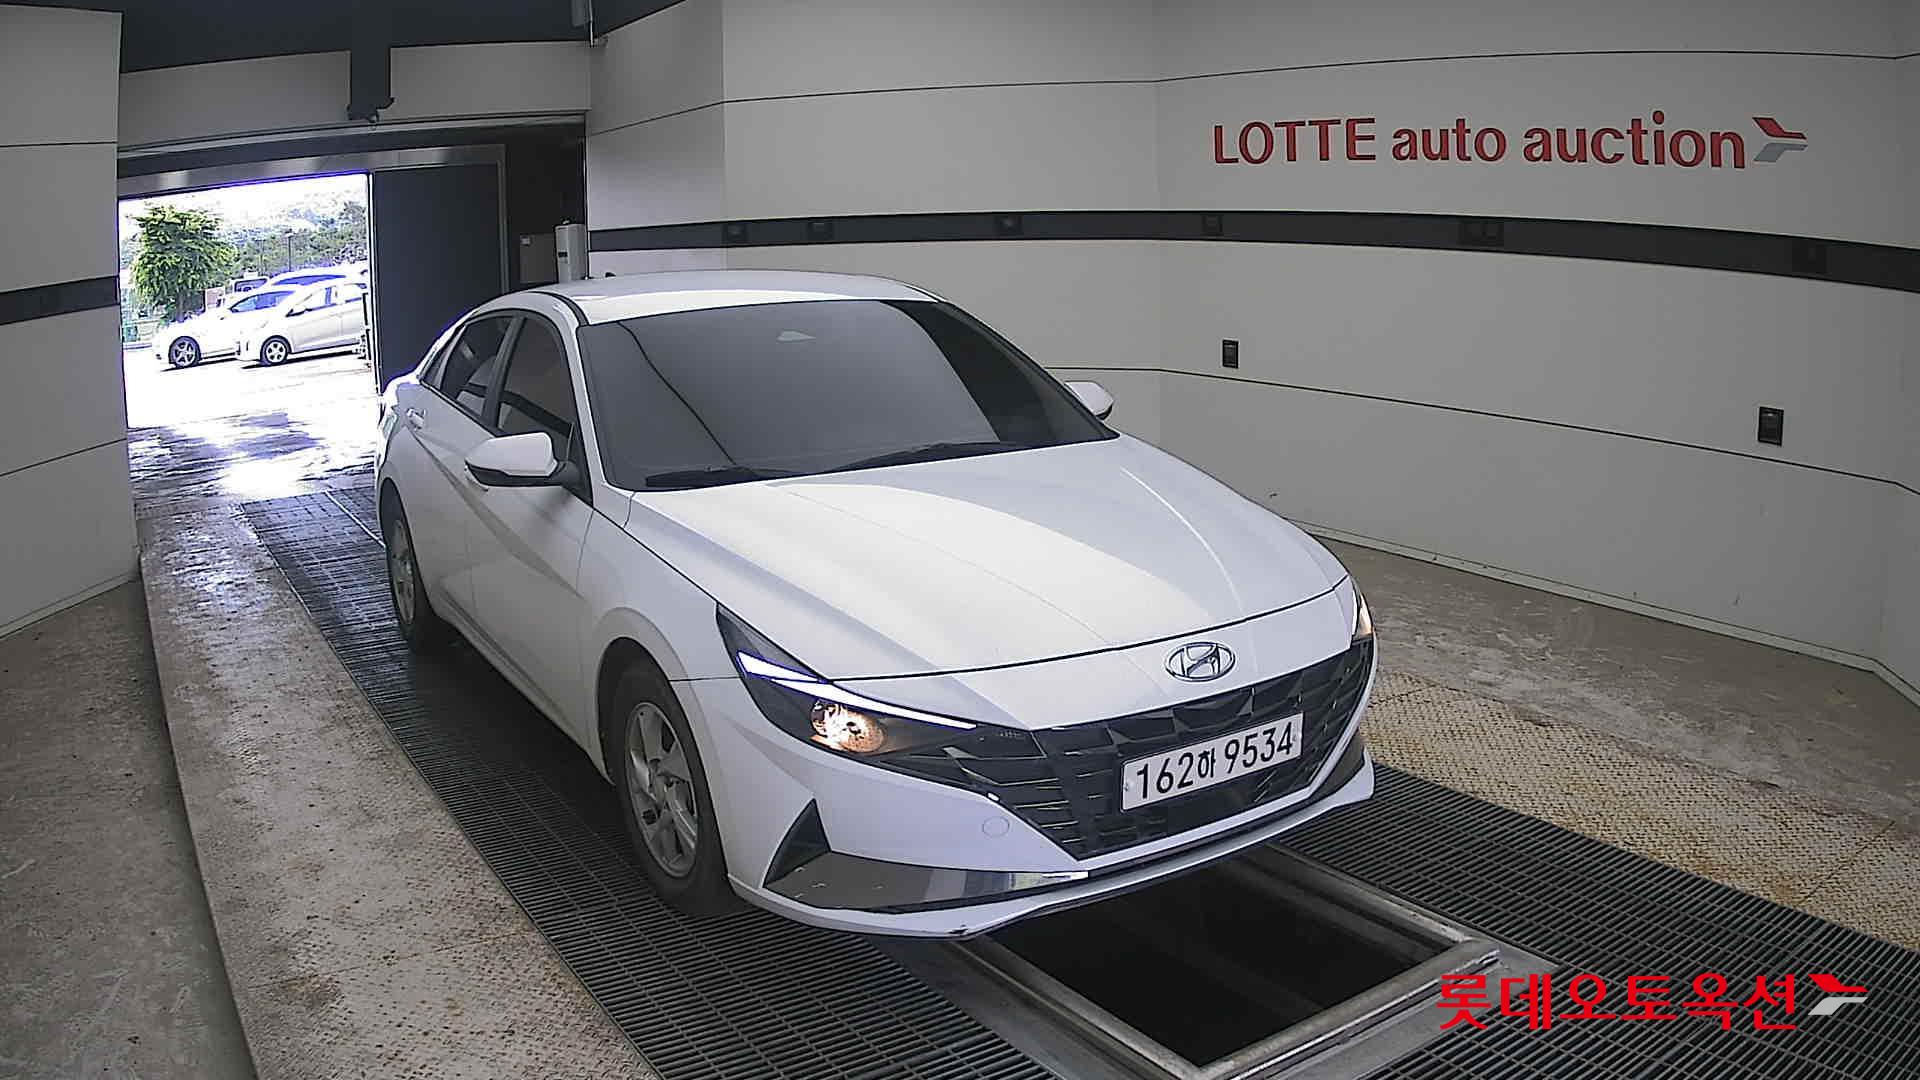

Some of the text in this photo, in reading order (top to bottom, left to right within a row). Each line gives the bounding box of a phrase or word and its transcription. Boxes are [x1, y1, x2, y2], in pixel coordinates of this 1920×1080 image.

[1213, 110, 1746, 169] LOTTE auto auction
[1137, 721, 1294, 799] 162하 9534
